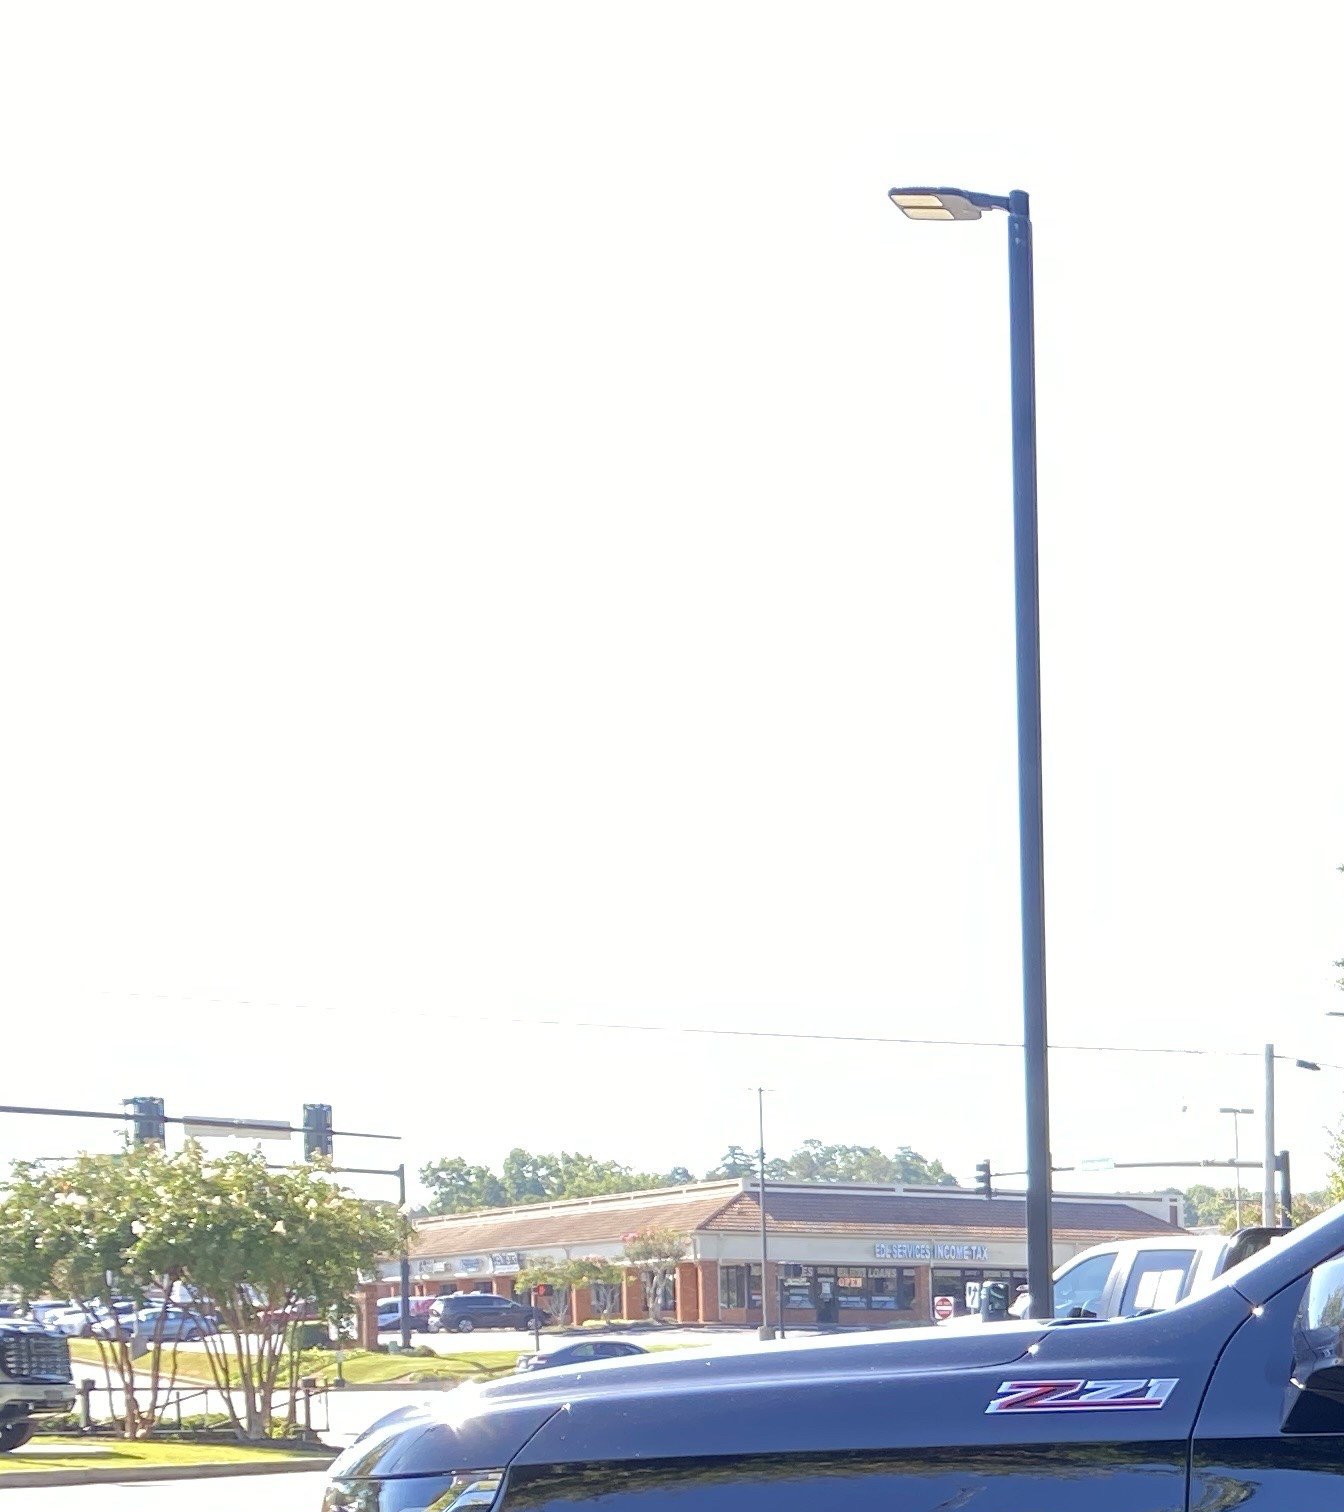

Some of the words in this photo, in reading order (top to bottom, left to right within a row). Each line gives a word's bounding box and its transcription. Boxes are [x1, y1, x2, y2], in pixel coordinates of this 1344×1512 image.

[893, 1244, 931, 1259] SERVICES
[934, 1244, 970, 1260] INCOME
[971, 1245, 989, 1261] TAX
[985, 1378, 1180, 1414] Z71
